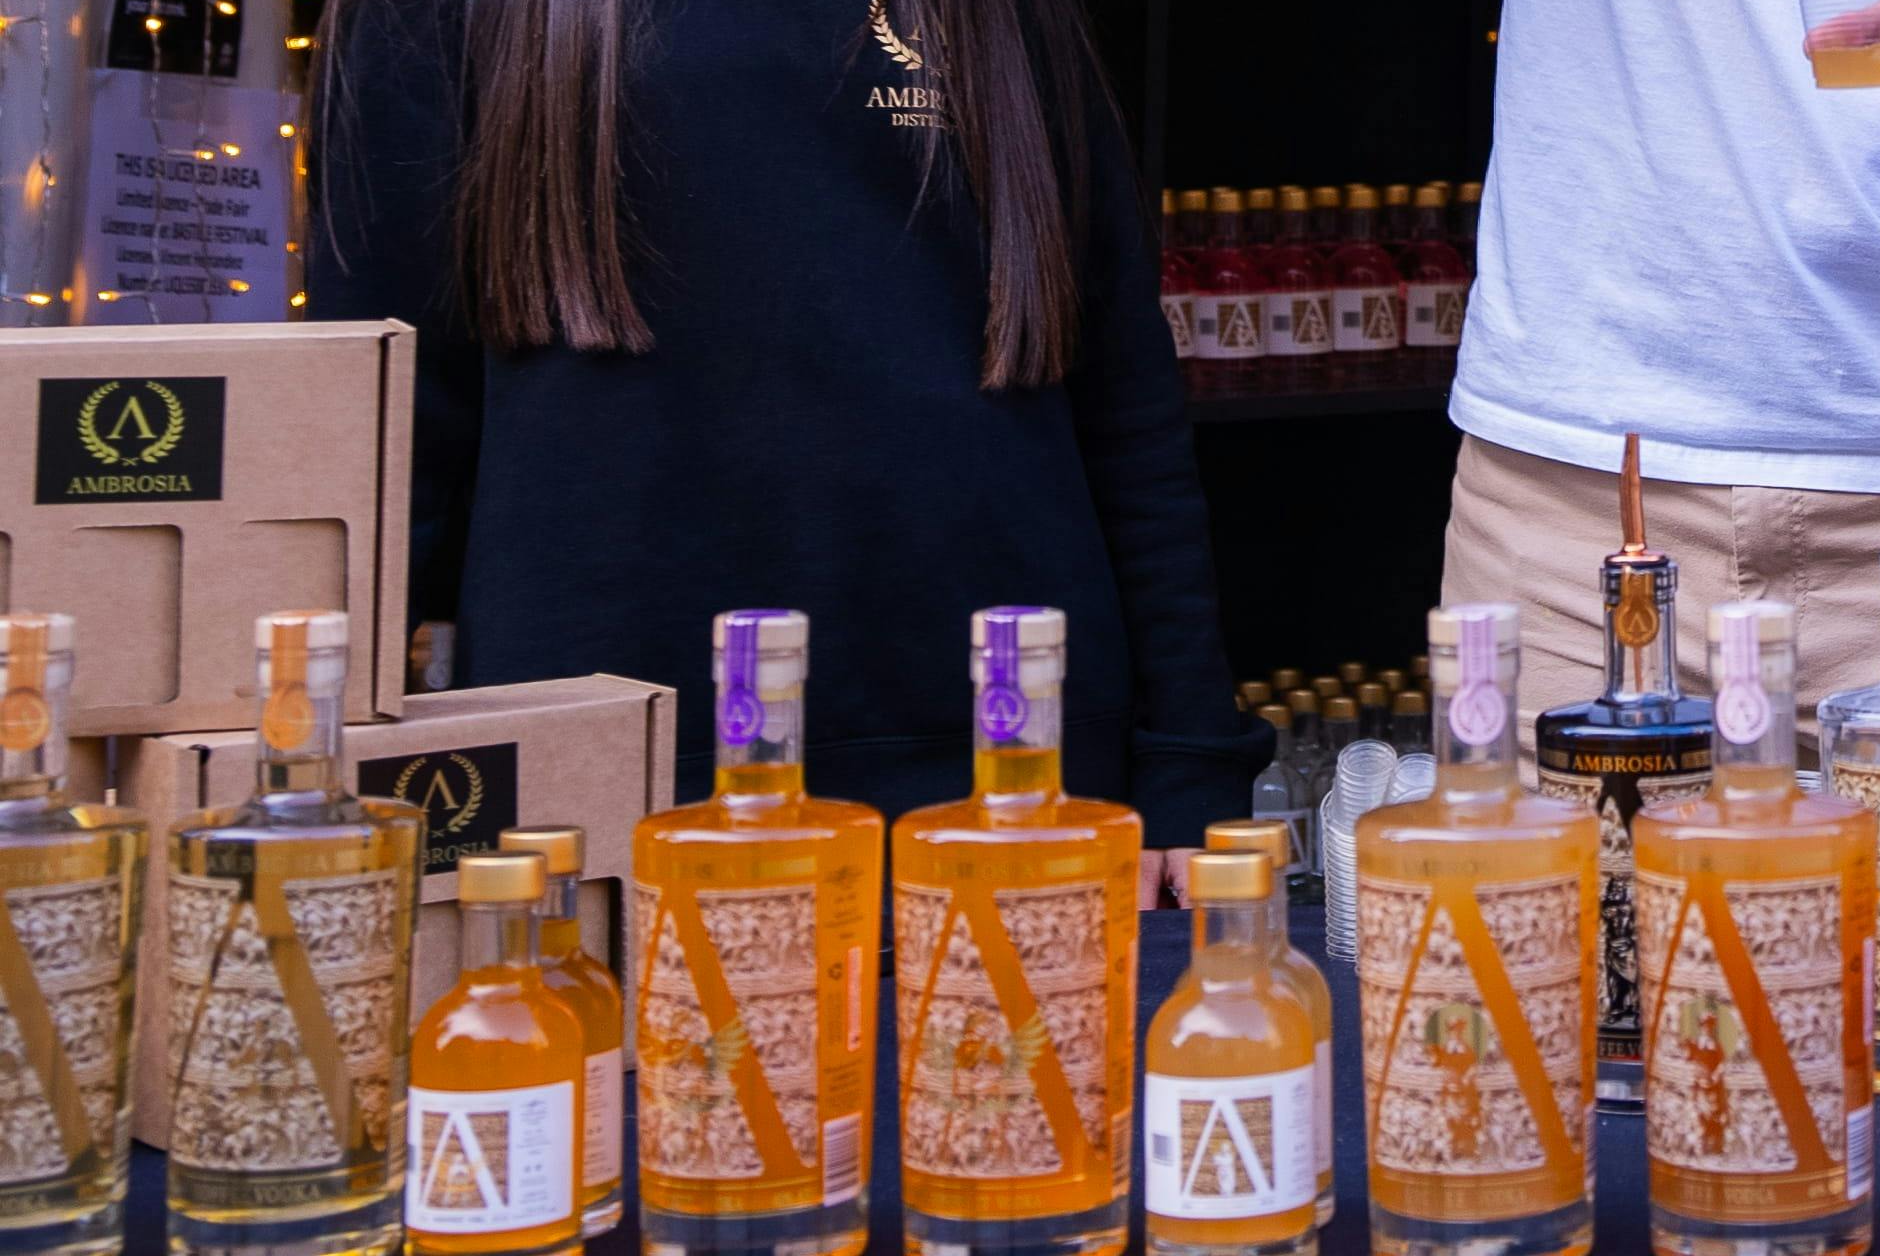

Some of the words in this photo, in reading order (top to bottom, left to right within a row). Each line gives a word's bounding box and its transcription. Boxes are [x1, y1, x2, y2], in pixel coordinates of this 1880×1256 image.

[222, 167, 261, 189] AREA
[66, 474, 193, 494] AMBROSIA
[1572, 753, 1677, 773] AMBROSIA
